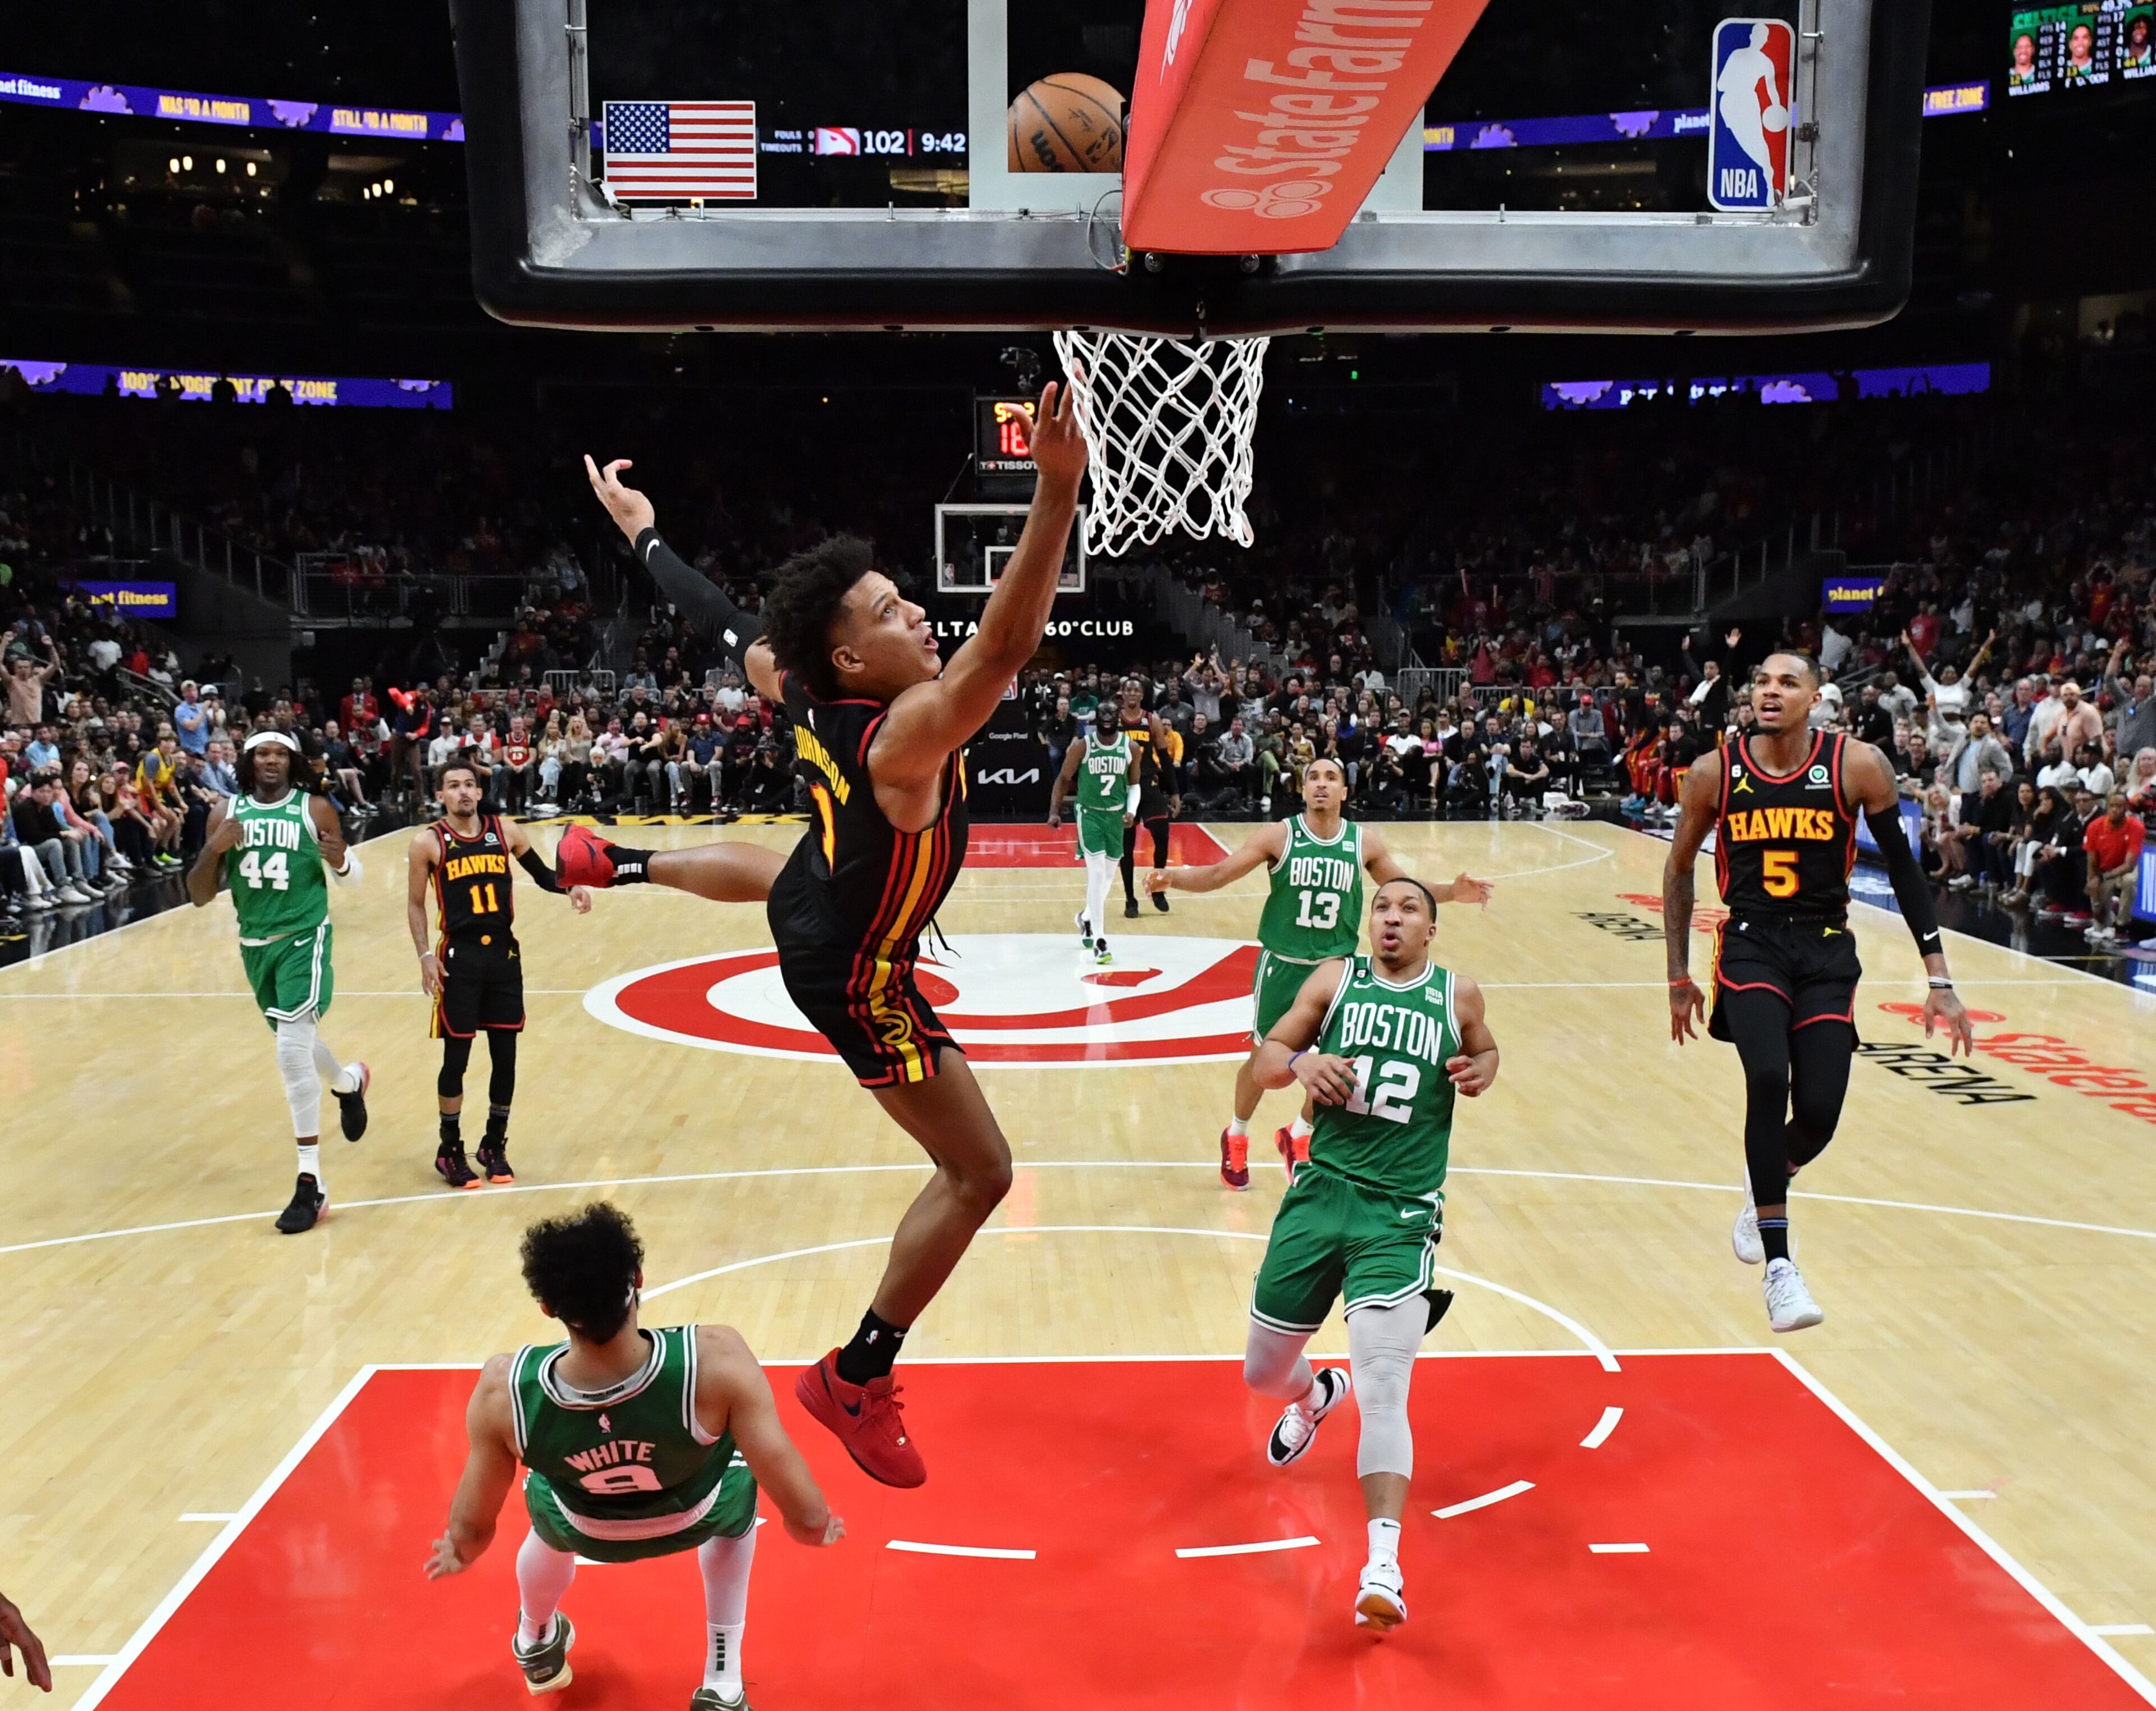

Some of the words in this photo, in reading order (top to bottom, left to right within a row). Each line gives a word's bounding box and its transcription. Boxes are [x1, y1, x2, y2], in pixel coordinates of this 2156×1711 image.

[2113, 11, 2125, 22] 17
[2057, 56, 2065, 66] 0
[2115, 47, 2123, 57] 0
[2116, 58, 2122, 69] 1
[17, 79, 61, 99] fitness
[2008, 80, 2050, 96] WILLIAMS
[202, 99, 211, 117] A
[332, 108, 363, 128] STILL
[381, 112, 390, 130] A
[774, 130, 802, 140] FOULS
[864, 130, 905, 154] 102
[921, 132, 966, 153] 9:42
[760, 143, 803, 153] TIMEOUTS
[1721, 168, 1758, 198] NBA
[298, 381, 337, 399] ZONE
[117, 590, 168, 605] fitness
[988, 732, 1012, 741] Google
[793, 724, 851, 806] JOHNSON
[1088, 756, 1127, 775] BOSTON
[1731, 765, 1742, 777] 6
[1100, 775, 1116, 796] 7
[1727, 807, 1834, 841] HAWKS
[235, 818, 300, 852] OSTON
[239, 850, 290, 891] 44
[445, 854, 506, 881] HAWKS
[1290, 857, 1355, 893] BOSTON
[1764, 850, 1799, 898] 5
[469, 883, 499, 914] 11
[1296, 890, 1341, 930] 13
[1356, 969, 1366, 978] 6
[1425, 986, 1444, 1000] VISTA
[1425, 994, 1444, 1006] PRINT
[1340, 1002, 1443, 1067] BOSTON
[1856, 1042, 2038, 1105] ARENA
[1345, 1054, 1421, 1124] 12
[563, 1439, 656, 1472] WHITE
[579, 1464, 664, 1495] 9
